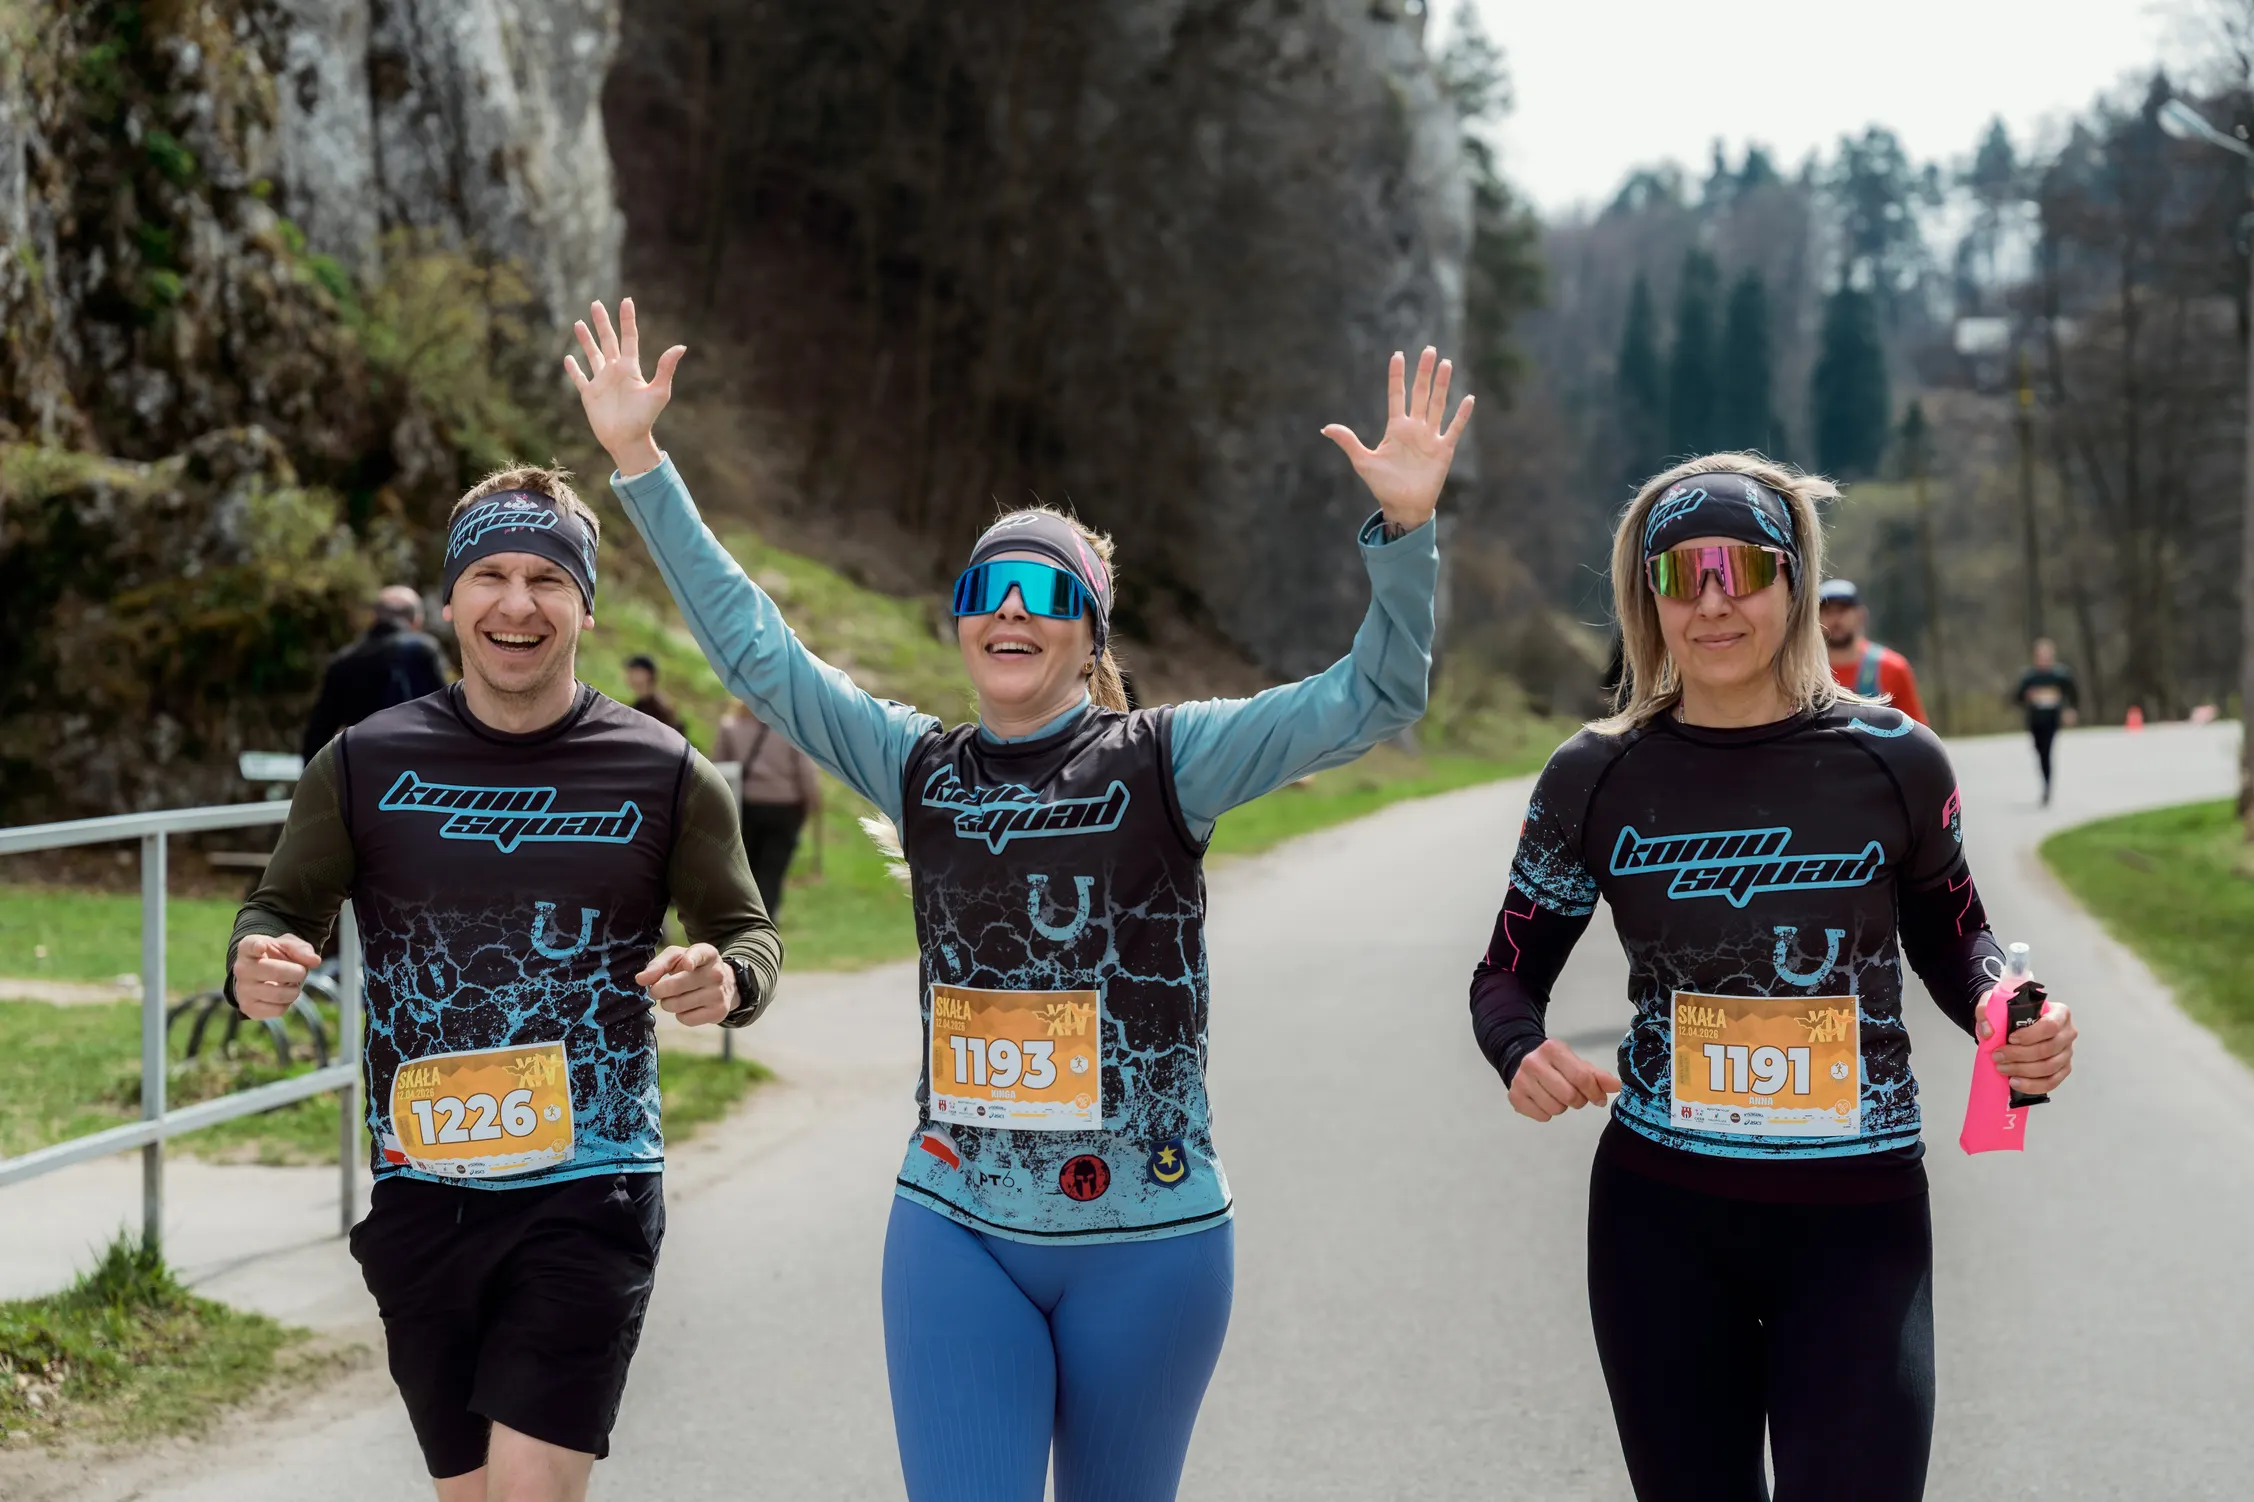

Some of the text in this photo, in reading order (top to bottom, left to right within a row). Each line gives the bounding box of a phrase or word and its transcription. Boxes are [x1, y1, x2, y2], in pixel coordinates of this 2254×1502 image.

[443, 802, 641, 851] squad
[1669, 841, 1884, 908] squad
[935, 996, 972, 1022] SKAŁA
[1678, 1004, 1727, 1029] SKAŁA
[1678, 1026, 1719, 1039] 12.04.2026
[950, 1035, 1057, 1089] 1193
[1703, 1043, 1811, 1095] 1191
[397, 1066, 441, 1090] SKAŁA
[397, 1088, 435, 1100] 12.04.2026
[991, 1089, 1016, 1099] KINGA
[1748, 1096, 1774, 1106] ANNA
[411, 1088, 538, 1145] 1226
